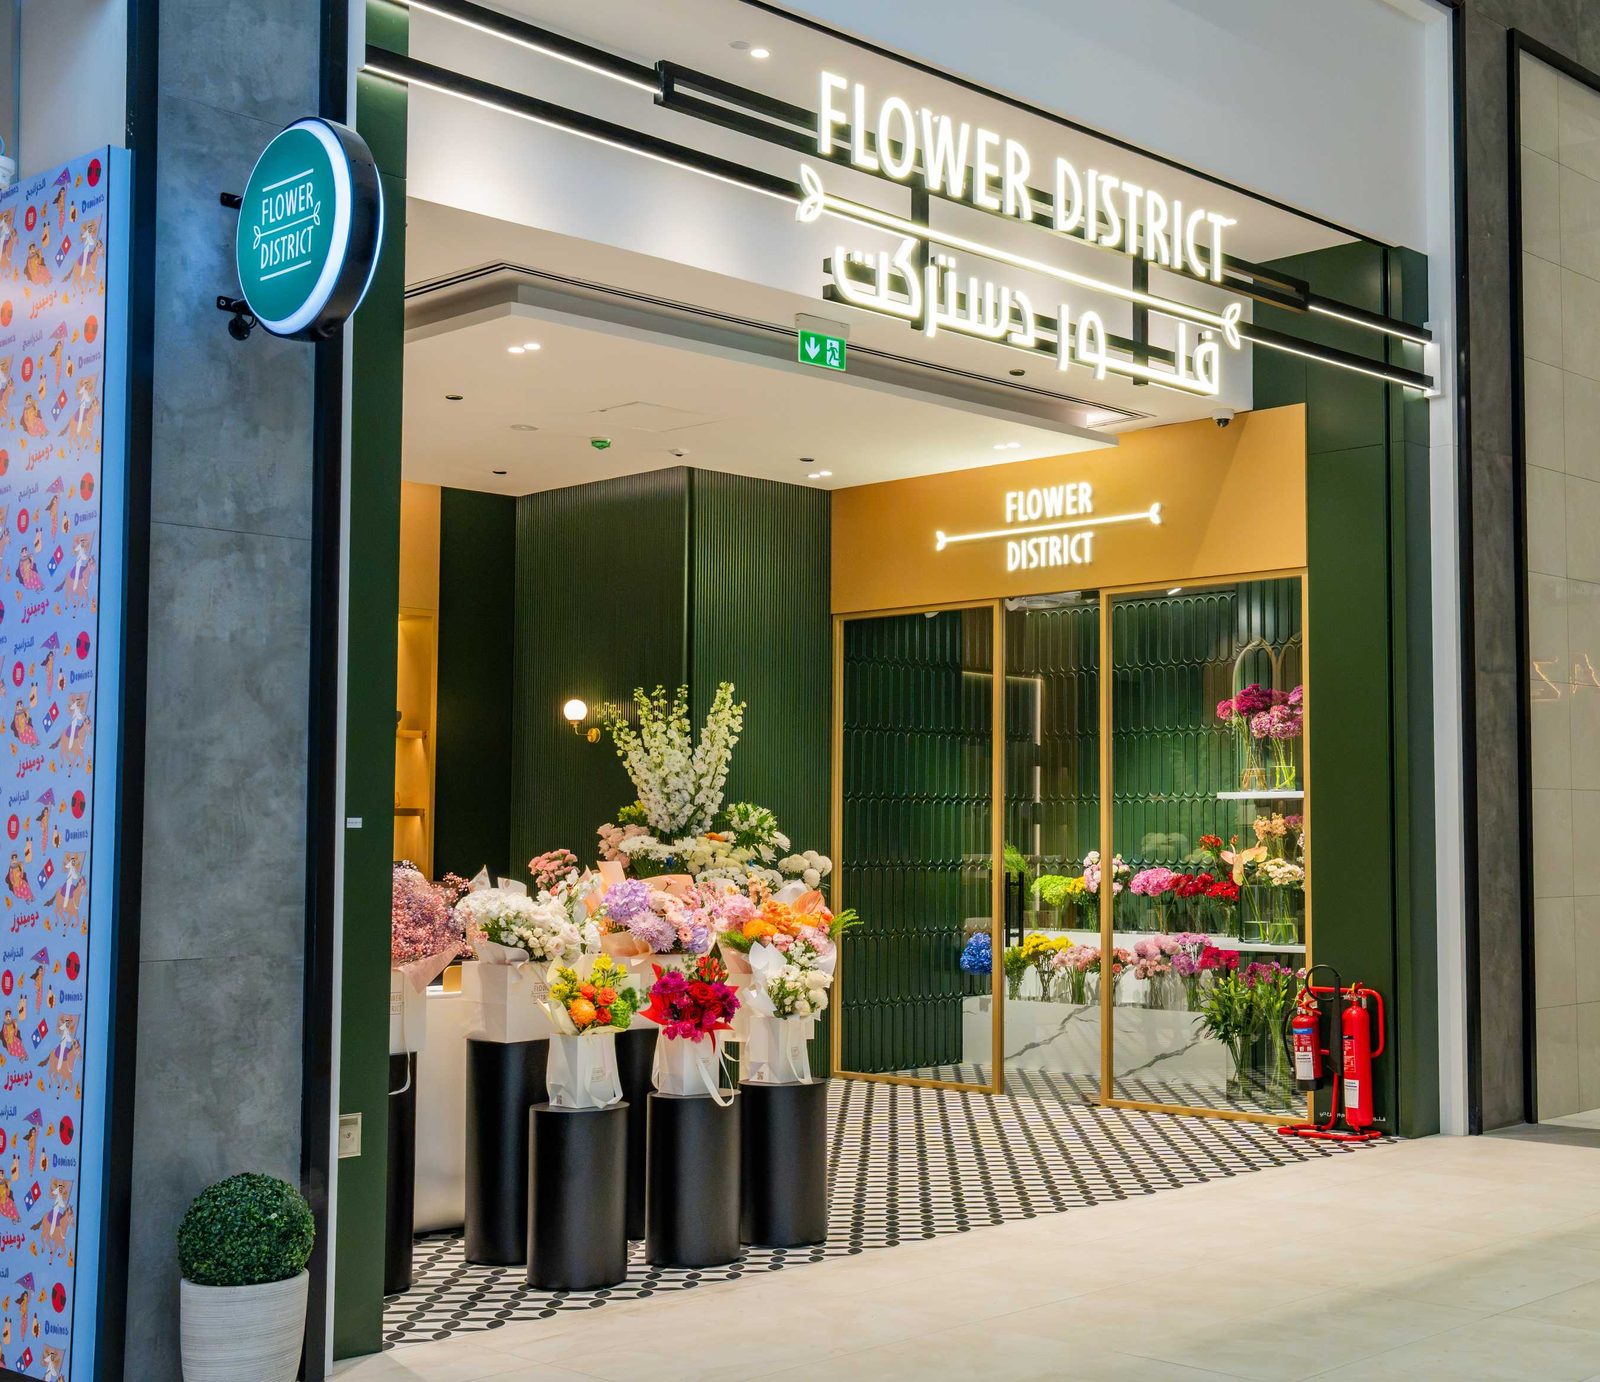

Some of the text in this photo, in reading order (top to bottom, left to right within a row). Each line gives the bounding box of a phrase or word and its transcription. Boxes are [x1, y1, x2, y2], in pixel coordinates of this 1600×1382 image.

[817, 70, 1237, 282] FLOWER DISTRICT
[261, 182, 314, 226] FLOWER
[260, 225, 314, 270] DISTRICT
[1005, 482, 1093, 524] FLOWER
[1007, 531, 1095, 572] DISTRICT
